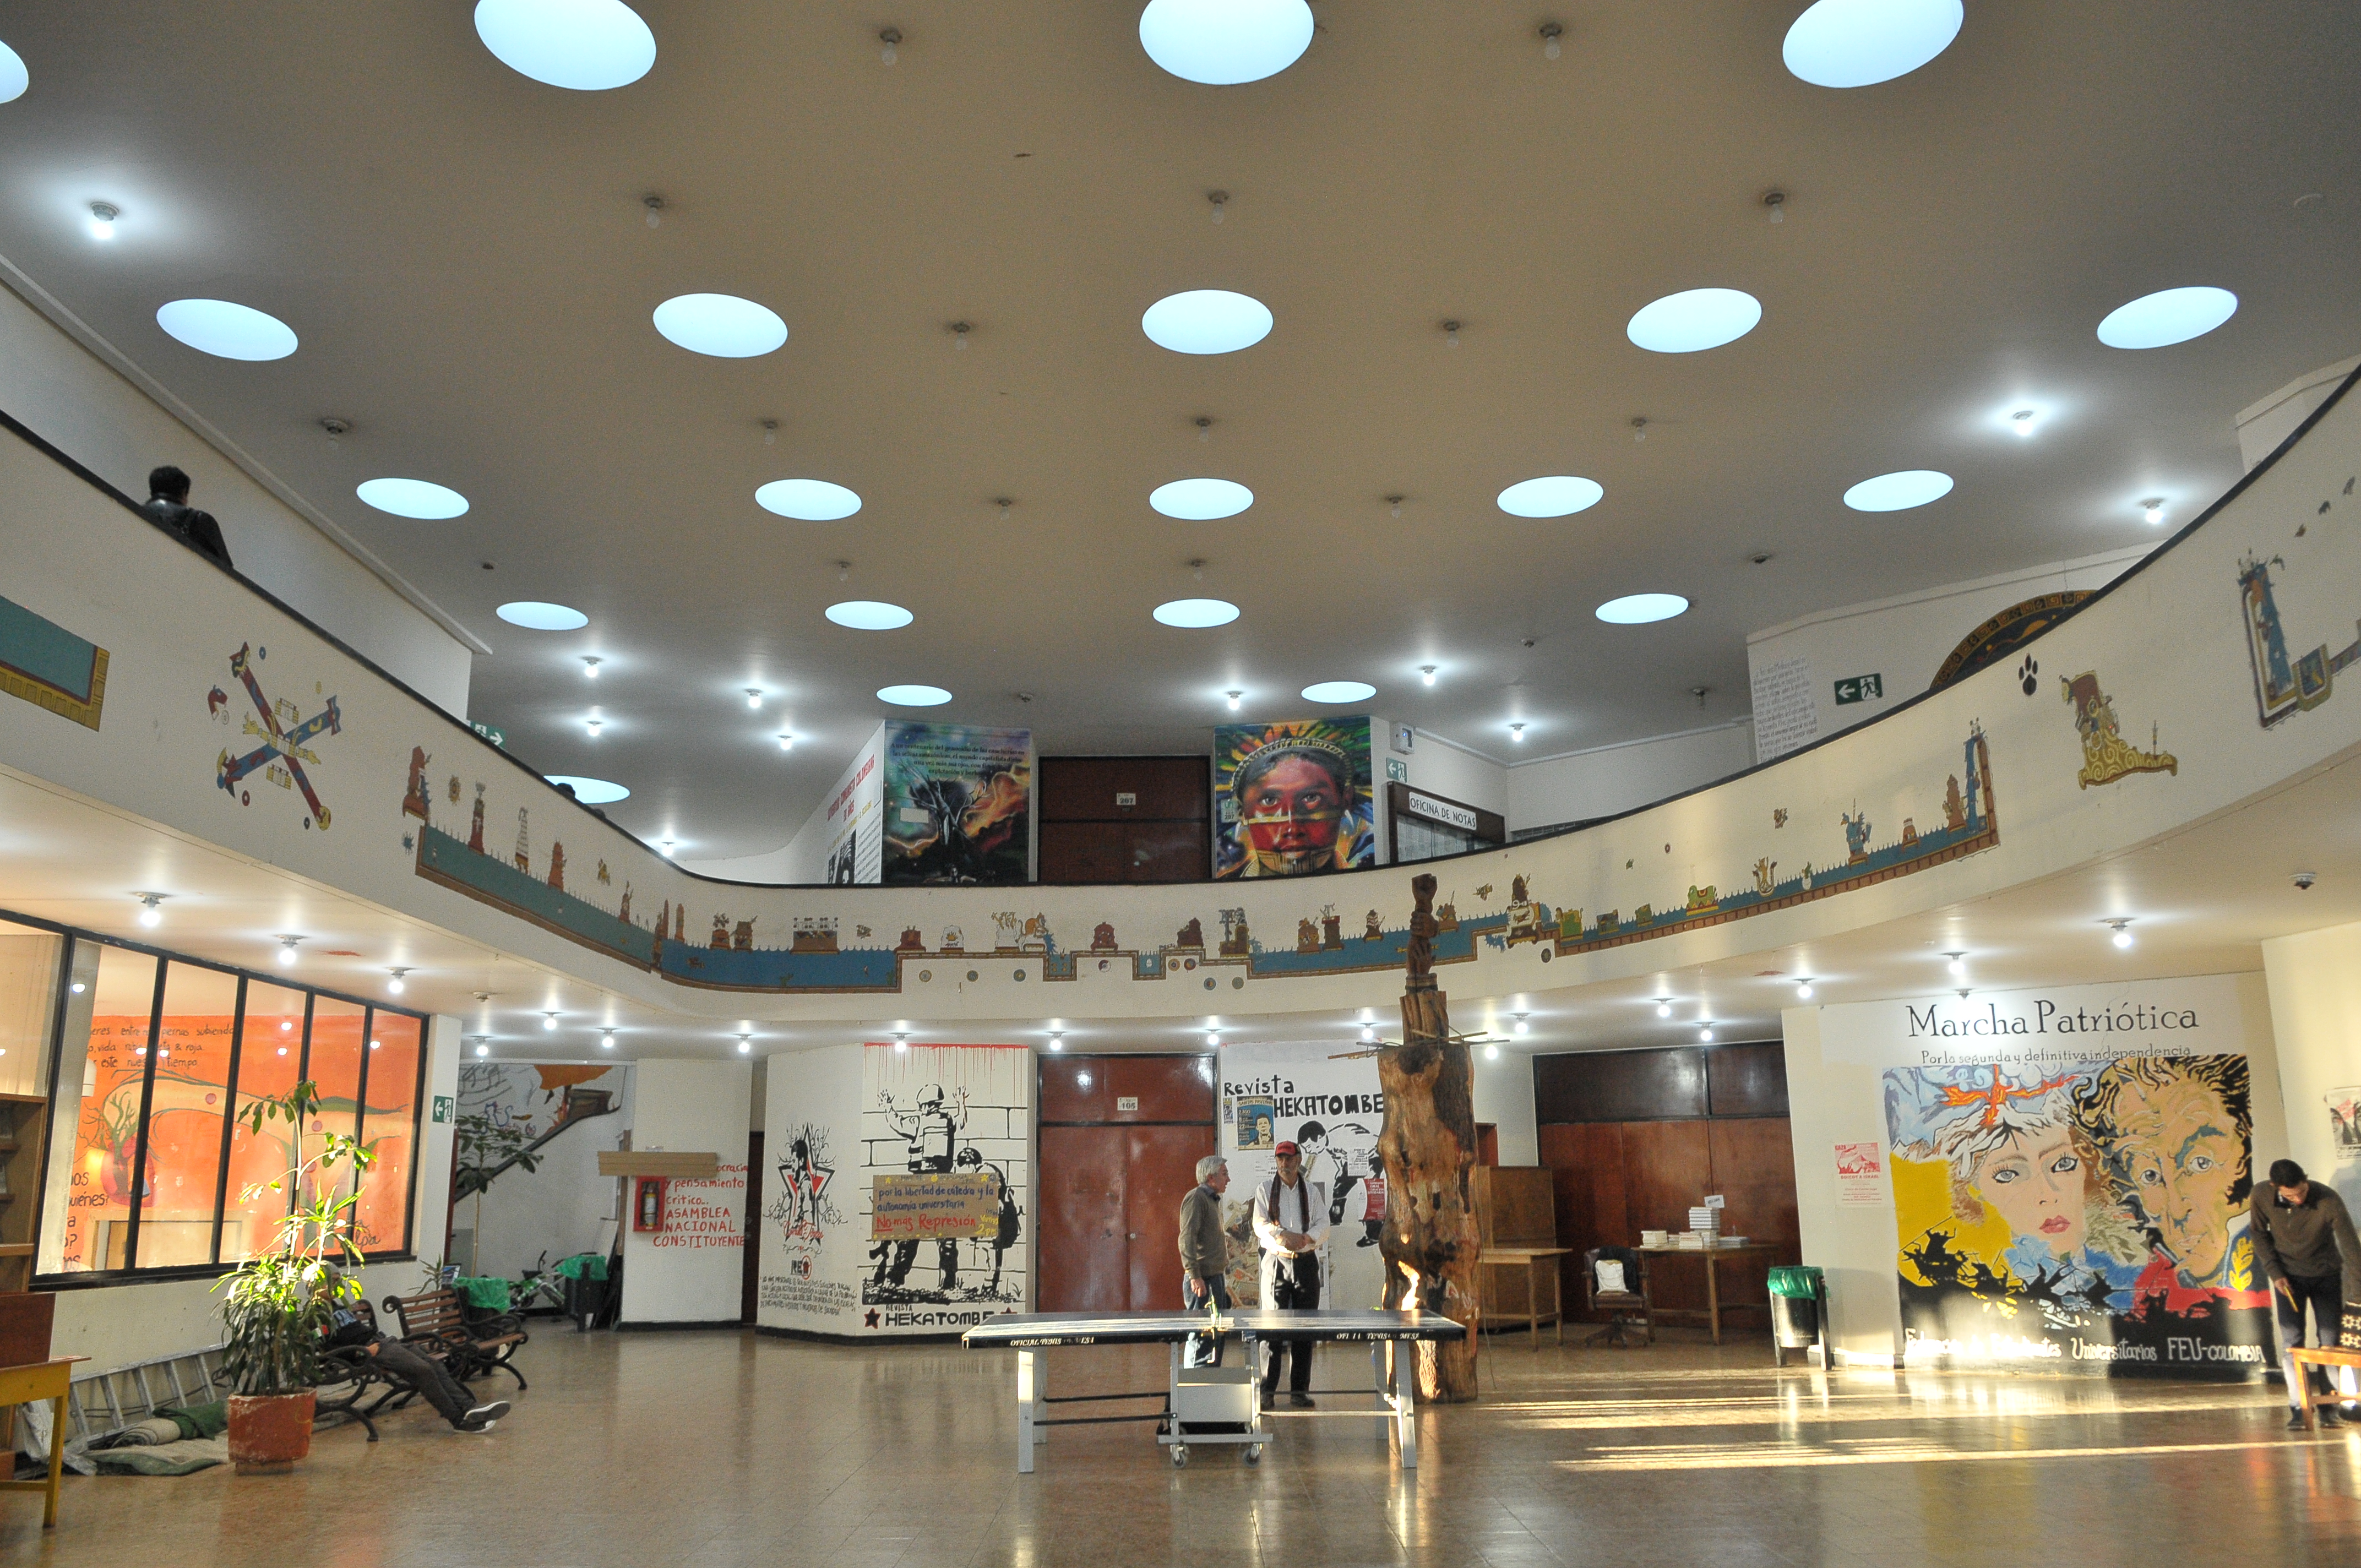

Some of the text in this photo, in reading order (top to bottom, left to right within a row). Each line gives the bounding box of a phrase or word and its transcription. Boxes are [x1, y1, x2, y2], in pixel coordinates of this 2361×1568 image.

[1410, 797, 1476, 827] OFICINA DE NOTAS
[1906, 999, 2200, 1037] Marcha Patriótica
[1921, 1043, 2191, 1066] Por la segunda y definitiva independencia
[1223, 1074, 1295, 1097] Revista
[1274, 1092, 1384, 1118] HEKATOMBE
[674, 1177, 744, 1192] pensamiento
[878, 1184, 994, 1201] por la libertad de cátedra y la
[918, 1199, 965, 1210] universitaria
[666, 1206, 731, 1221] ASAMBLEA
[665, 1220, 736, 1233] NACIONAL
[876, 1213, 892, 1229] No
[918, 1213, 976, 1232] Represión
[653, 1235, 744, 1249] CONSTITUYENTE
[885, 1310, 995, 1327] HEKATOMBE
[1010, 1338, 1040, 1347] OFICIAL
[2070, 1337, 2158, 1361] Universitarios
